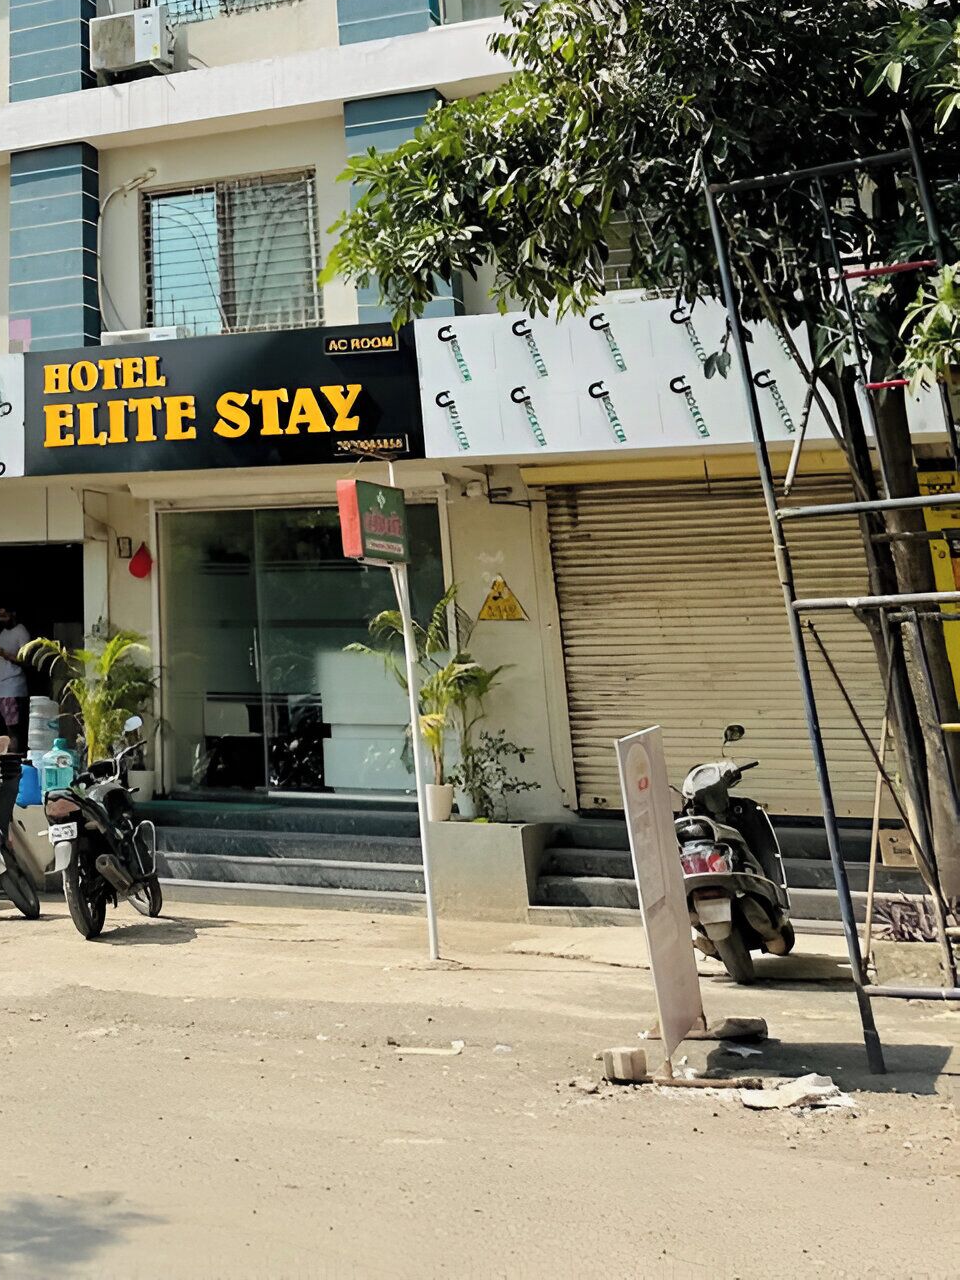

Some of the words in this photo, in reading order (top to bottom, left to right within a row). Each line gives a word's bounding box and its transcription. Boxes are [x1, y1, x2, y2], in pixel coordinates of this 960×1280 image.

[329, 340, 348, 351] AC
[350, 336, 393, 350] ROOM
[43, 356, 166, 394] HOTEL
[43, 395, 197, 448] ELITE
[213, 384, 362, 438] STAY
